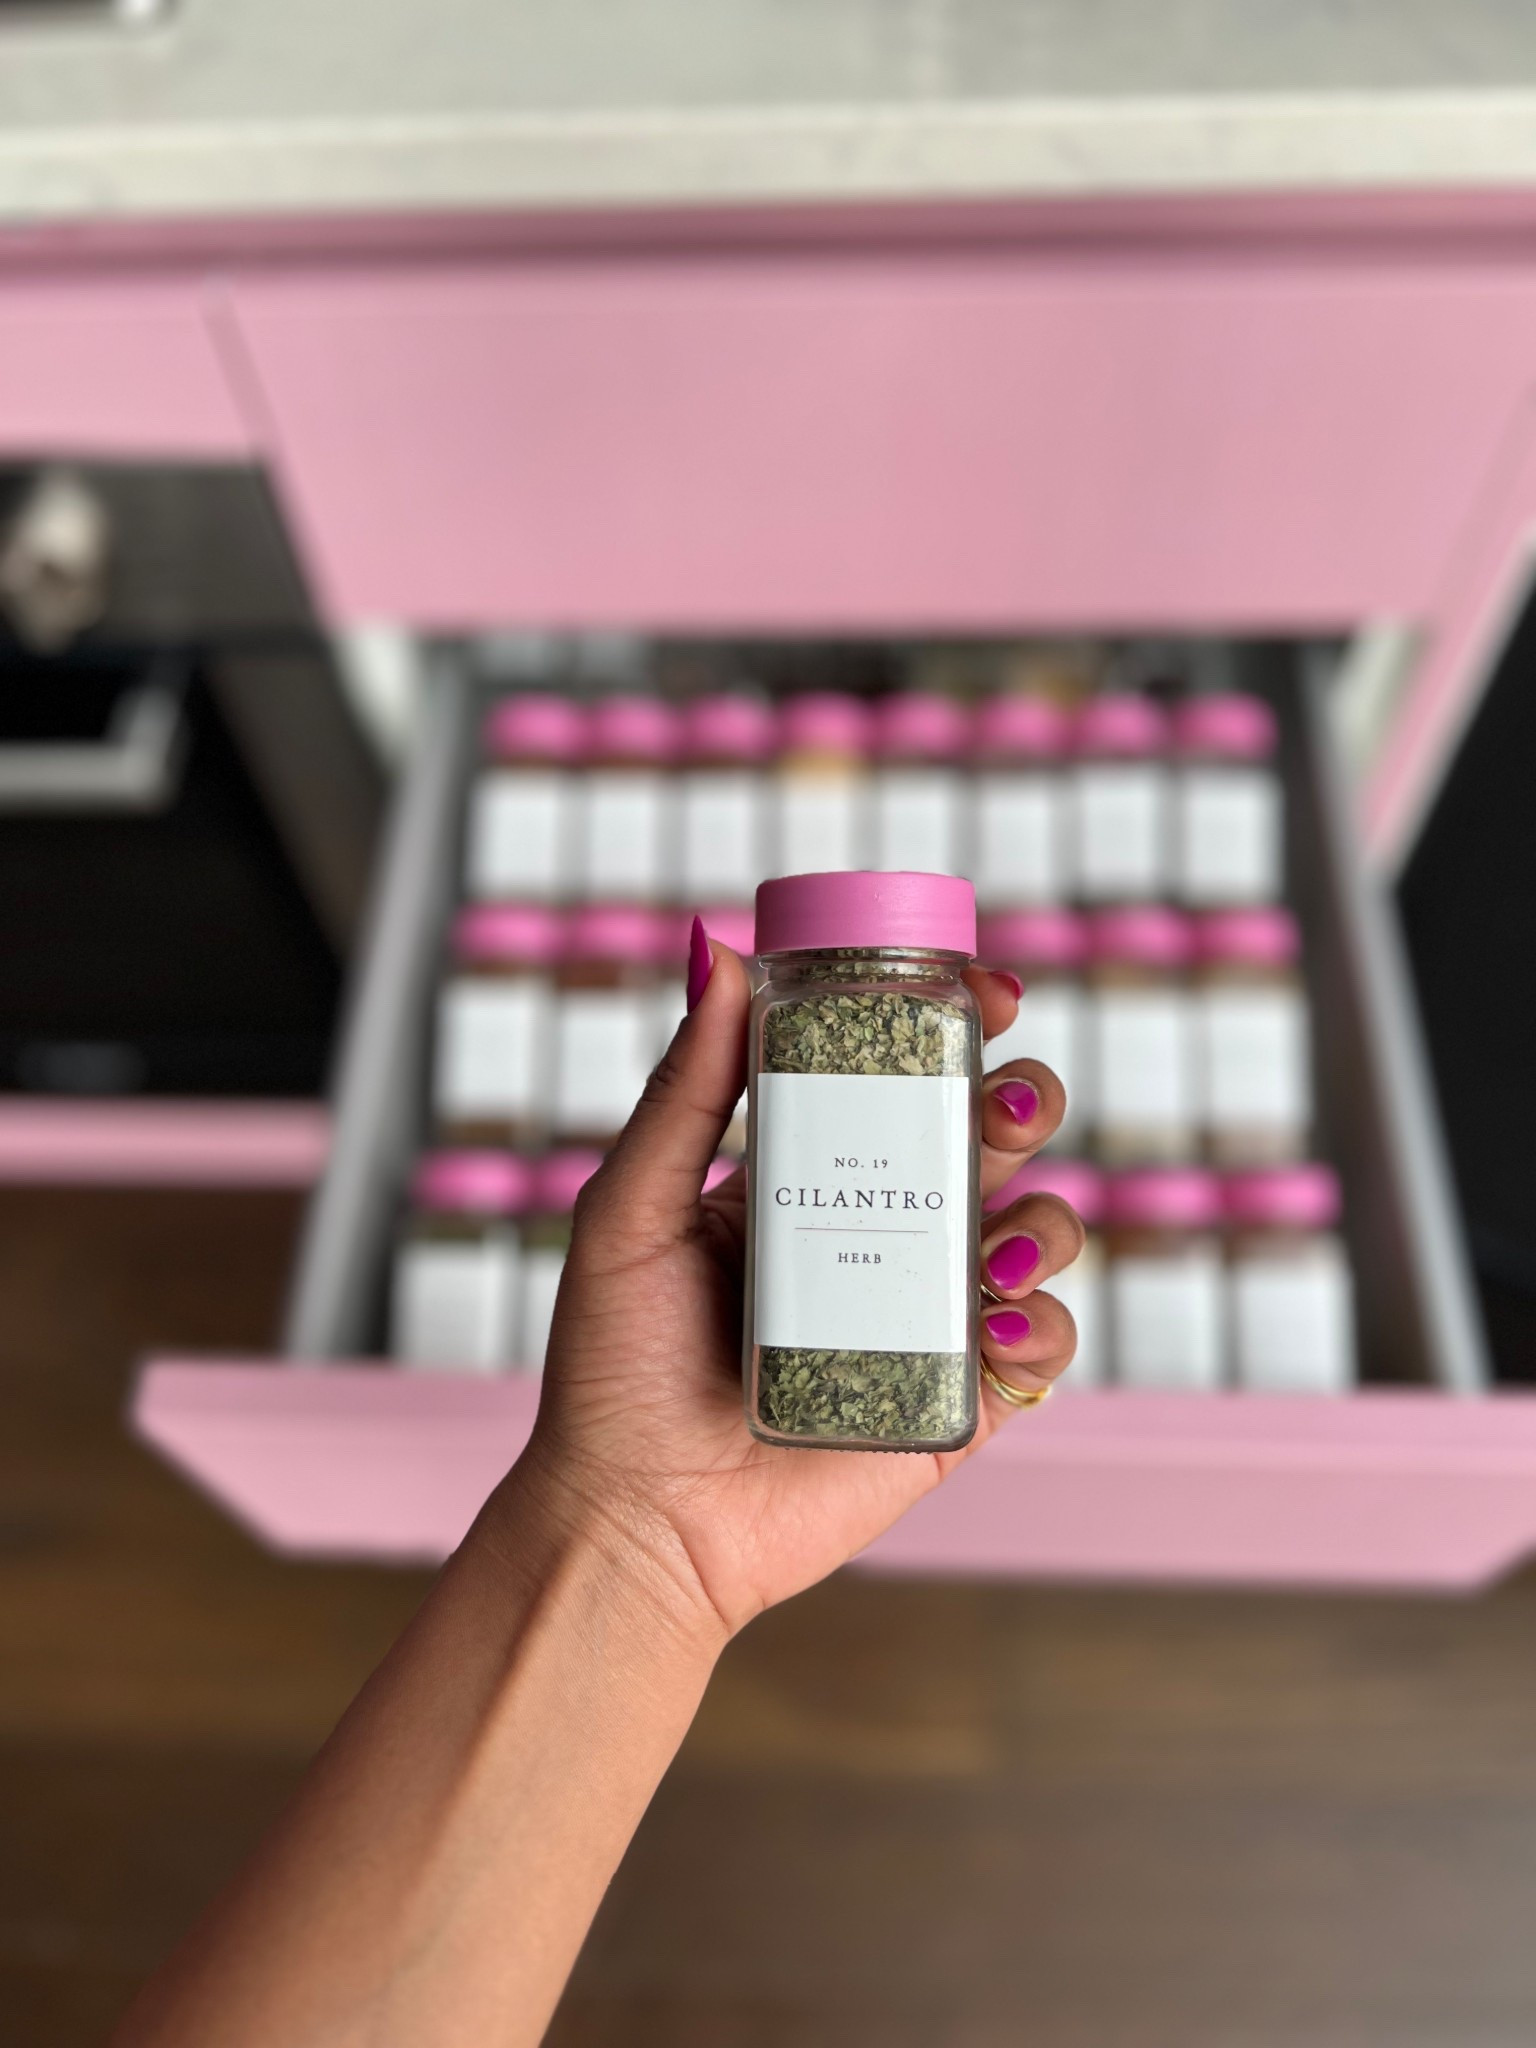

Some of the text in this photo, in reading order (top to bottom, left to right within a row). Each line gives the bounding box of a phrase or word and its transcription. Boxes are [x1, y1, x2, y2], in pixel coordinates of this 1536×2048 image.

[834, 1157, 889, 1169] NO. 19
[775, 1187, 944, 1210] CILANTRO
[837, 1252, 882, 1264] HERB
